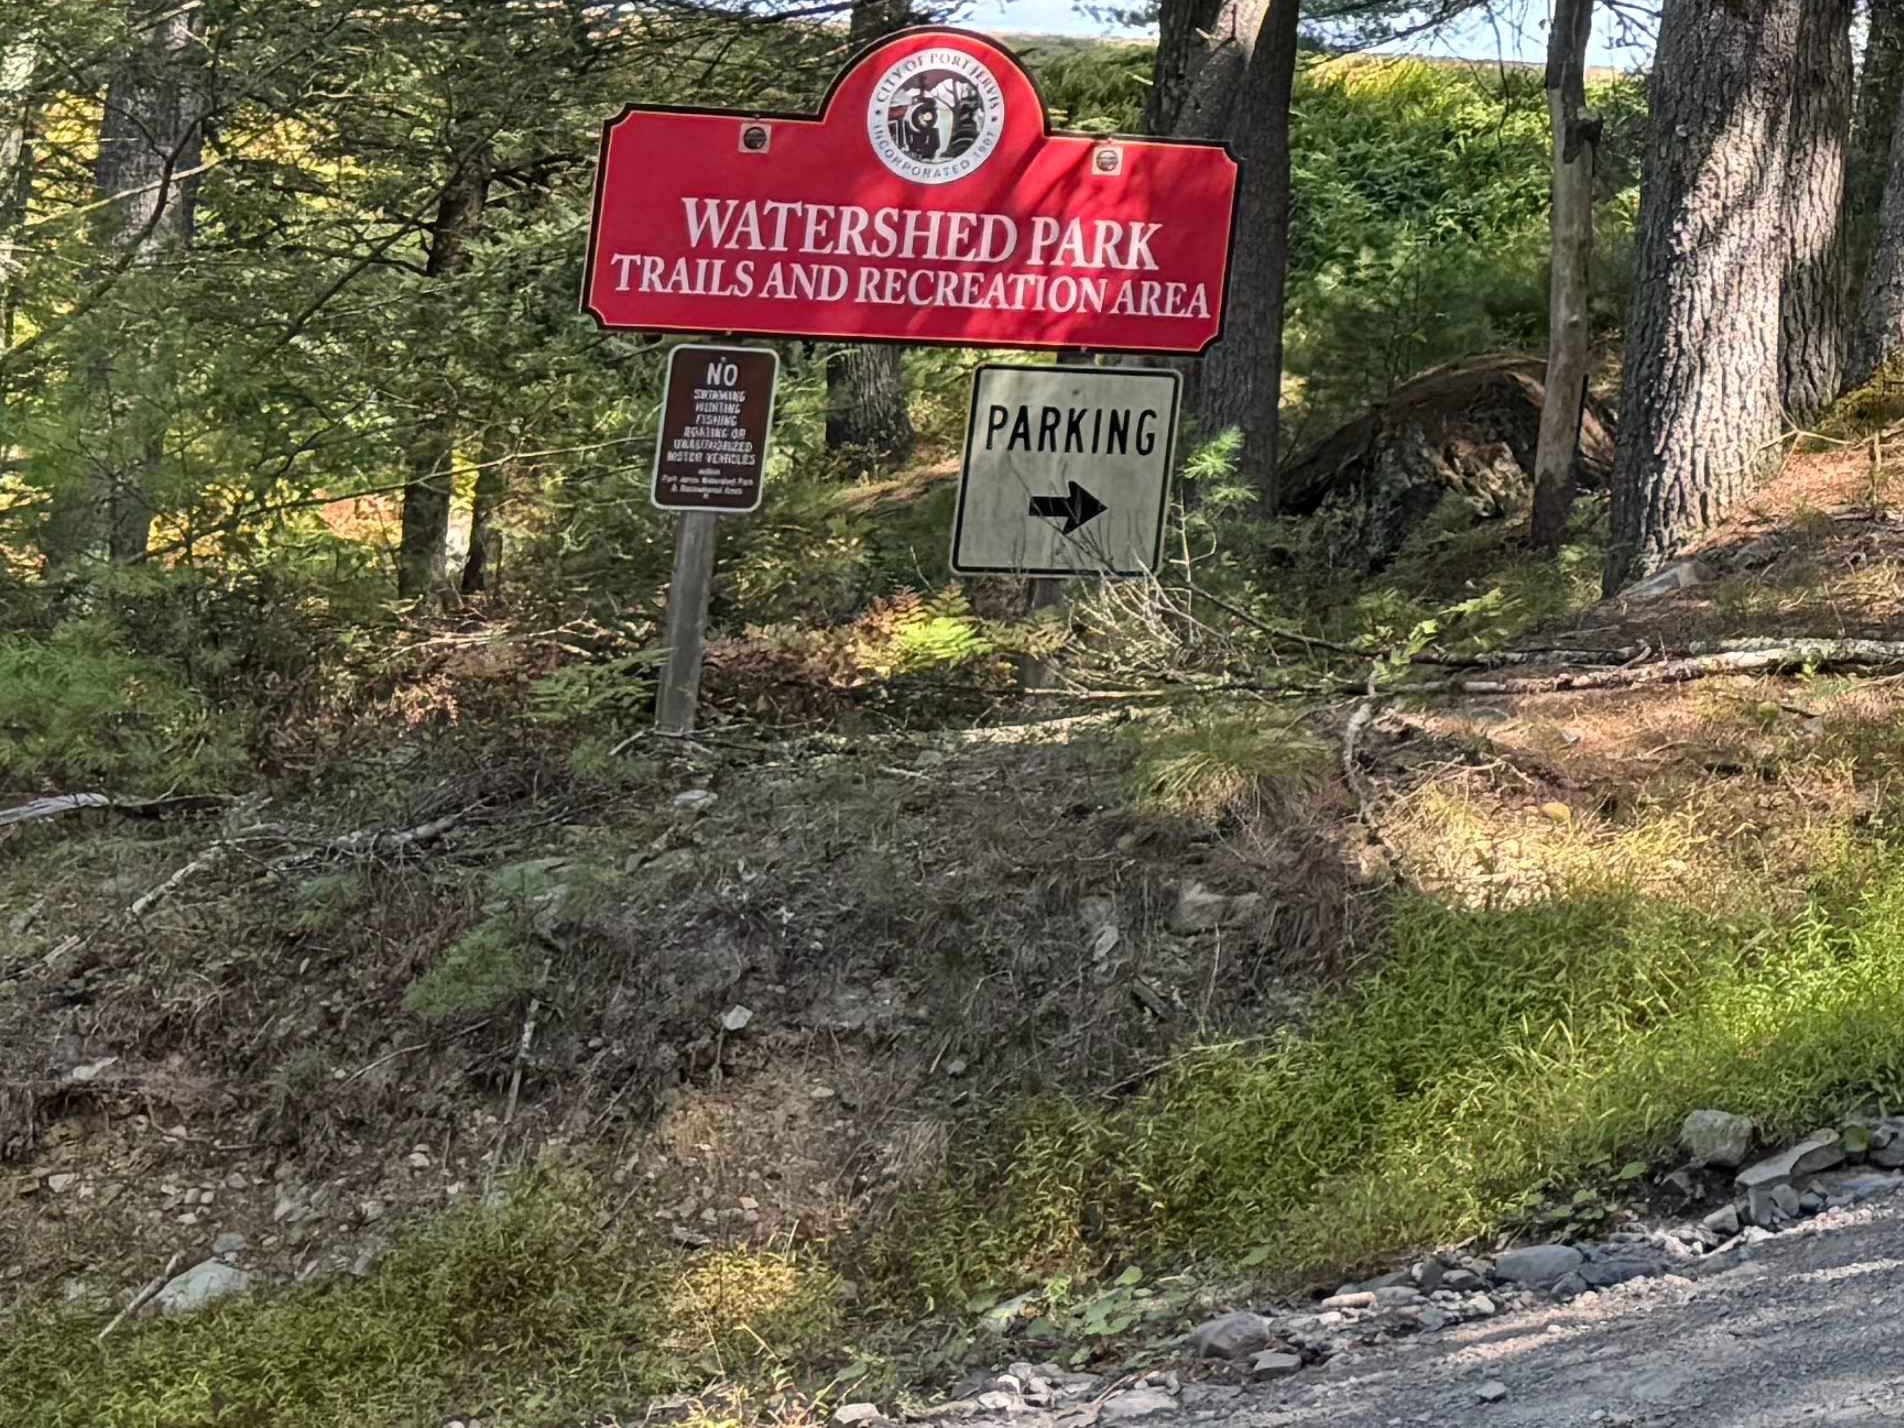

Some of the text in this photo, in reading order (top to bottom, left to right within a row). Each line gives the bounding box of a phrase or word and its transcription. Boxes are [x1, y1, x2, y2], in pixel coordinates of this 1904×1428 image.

[876, 53, 1000, 110] CITY OF PORT JERVIS
[872, 124, 971, 178] INCORPORATED
[681, 197, 1163, 270] WATERSHED PARK
[611, 253, 1211, 318] TRAILS AND RECREATION AREA
[706, 362, 738, 386] NO
[695, 414, 738, 426] FISHING
[986, 405, 1157, 456] PARKING
